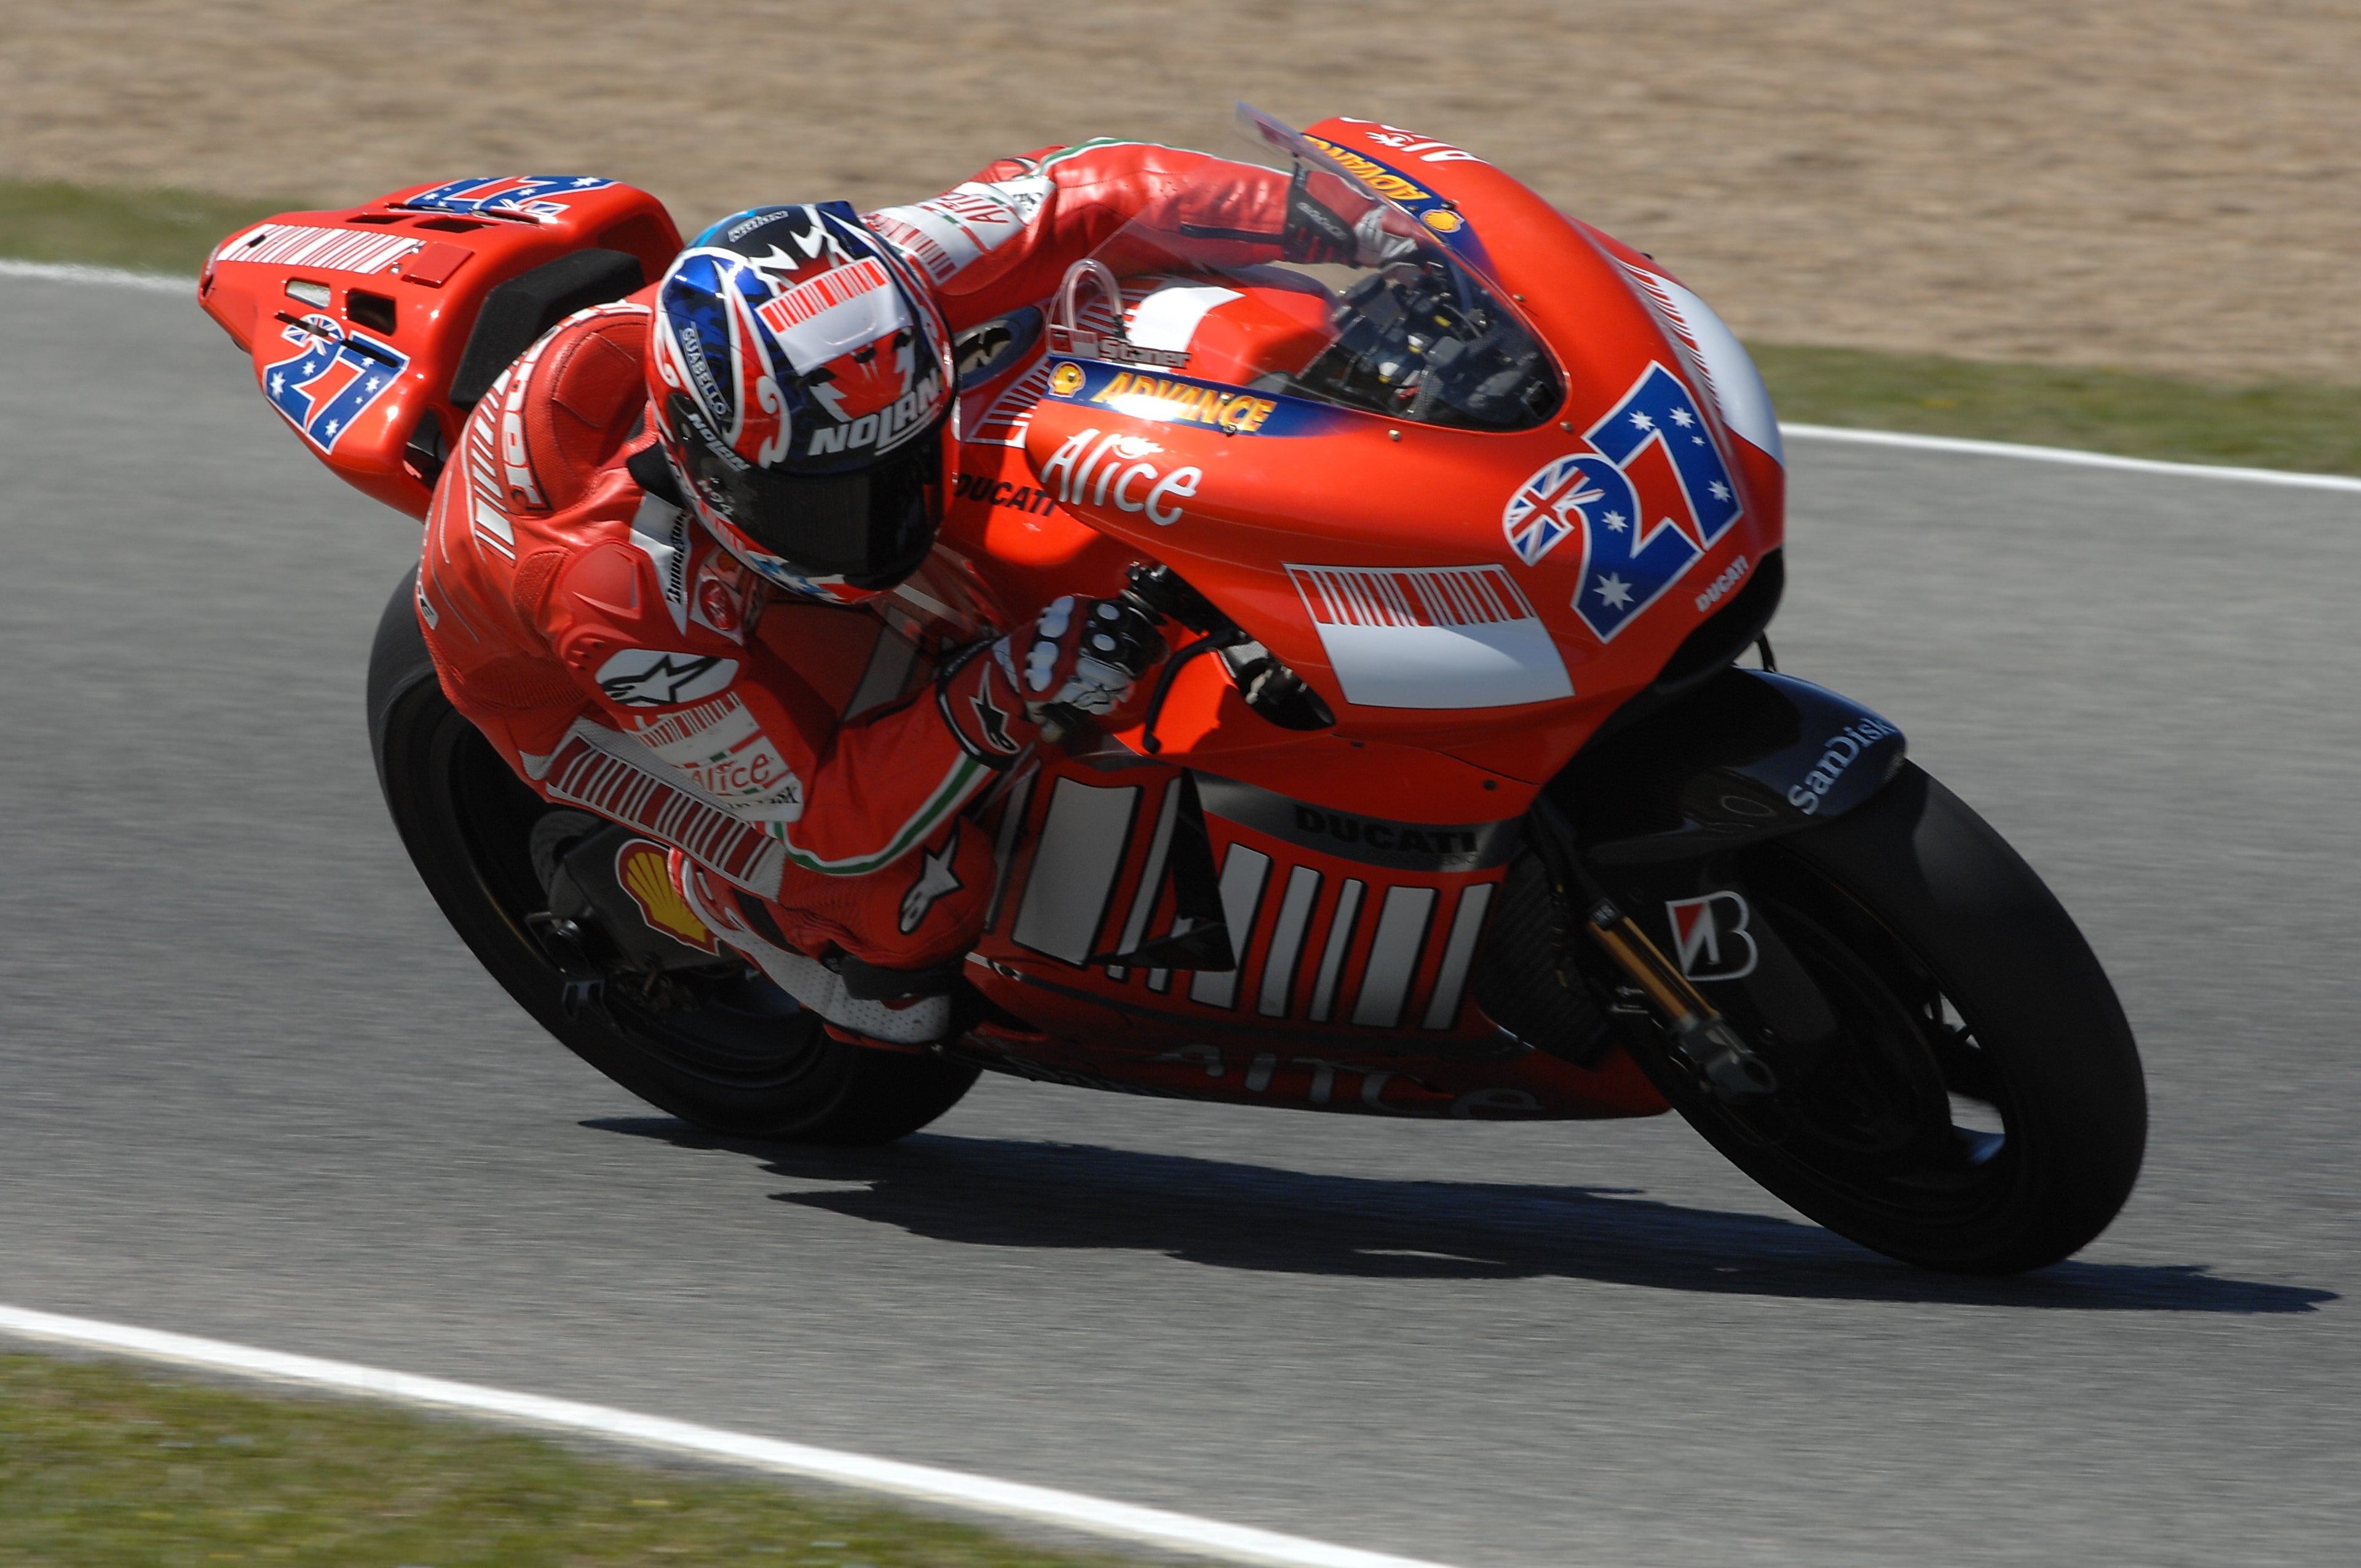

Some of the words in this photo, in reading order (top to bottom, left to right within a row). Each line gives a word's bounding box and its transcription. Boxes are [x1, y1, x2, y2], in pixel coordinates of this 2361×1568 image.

[1303, 135, 1431, 200] ADVANC
[263, 314, 411, 455] 27
[682, 327, 730, 417] GUABELLO
[1100, 336, 1191, 369] Stoner
[808, 370, 944, 456] NOLAN
[1090, 372, 1278, 432] ADVANCE
[954, 473, 1055, 517] DUCATI
[1040, 429, 1203, 526] Alice
[1502, 360, 1744, 644] 27
[1695, 555, 1749, 613] DUCATI
[691, 753, 771, 794] Alice
[1788, 715, 1899, 815] SanDisk
[1294, 803, 1476, 854] DUCATI
